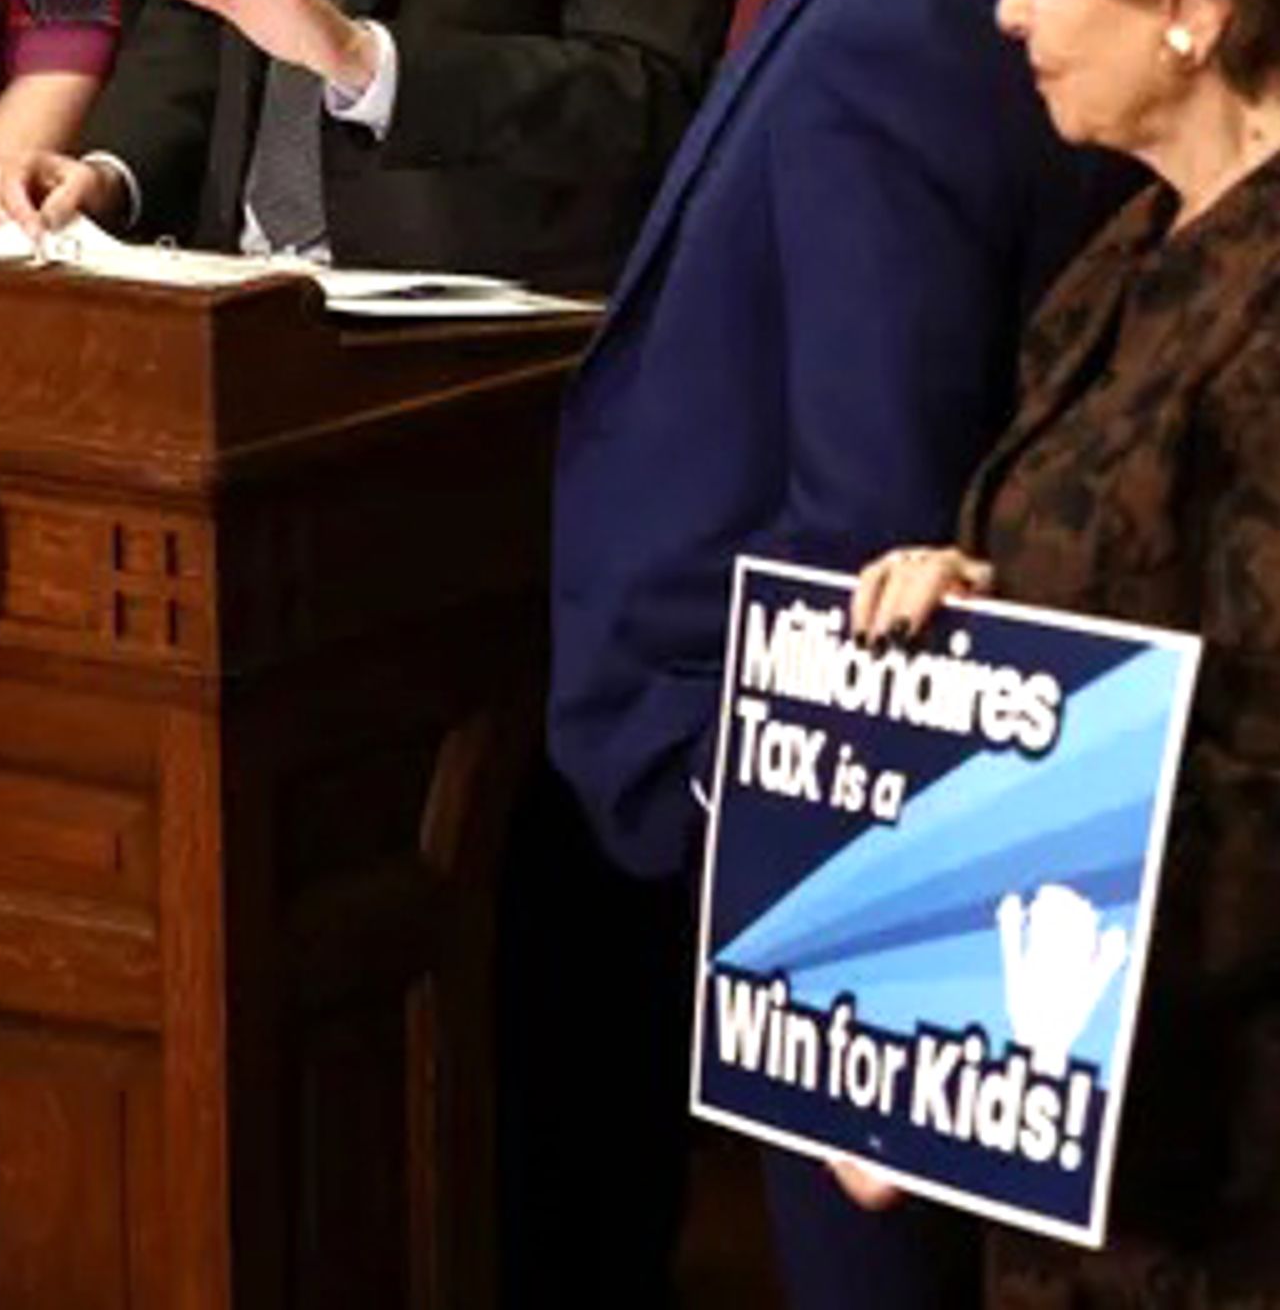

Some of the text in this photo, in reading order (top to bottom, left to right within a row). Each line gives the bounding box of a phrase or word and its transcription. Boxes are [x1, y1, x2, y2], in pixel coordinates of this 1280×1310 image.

[742, 598, 1062, 752] Millionaires
[737, 696, 907, 820] Tax is a
[715, 972, 1094, 1174] Win for Kids!
